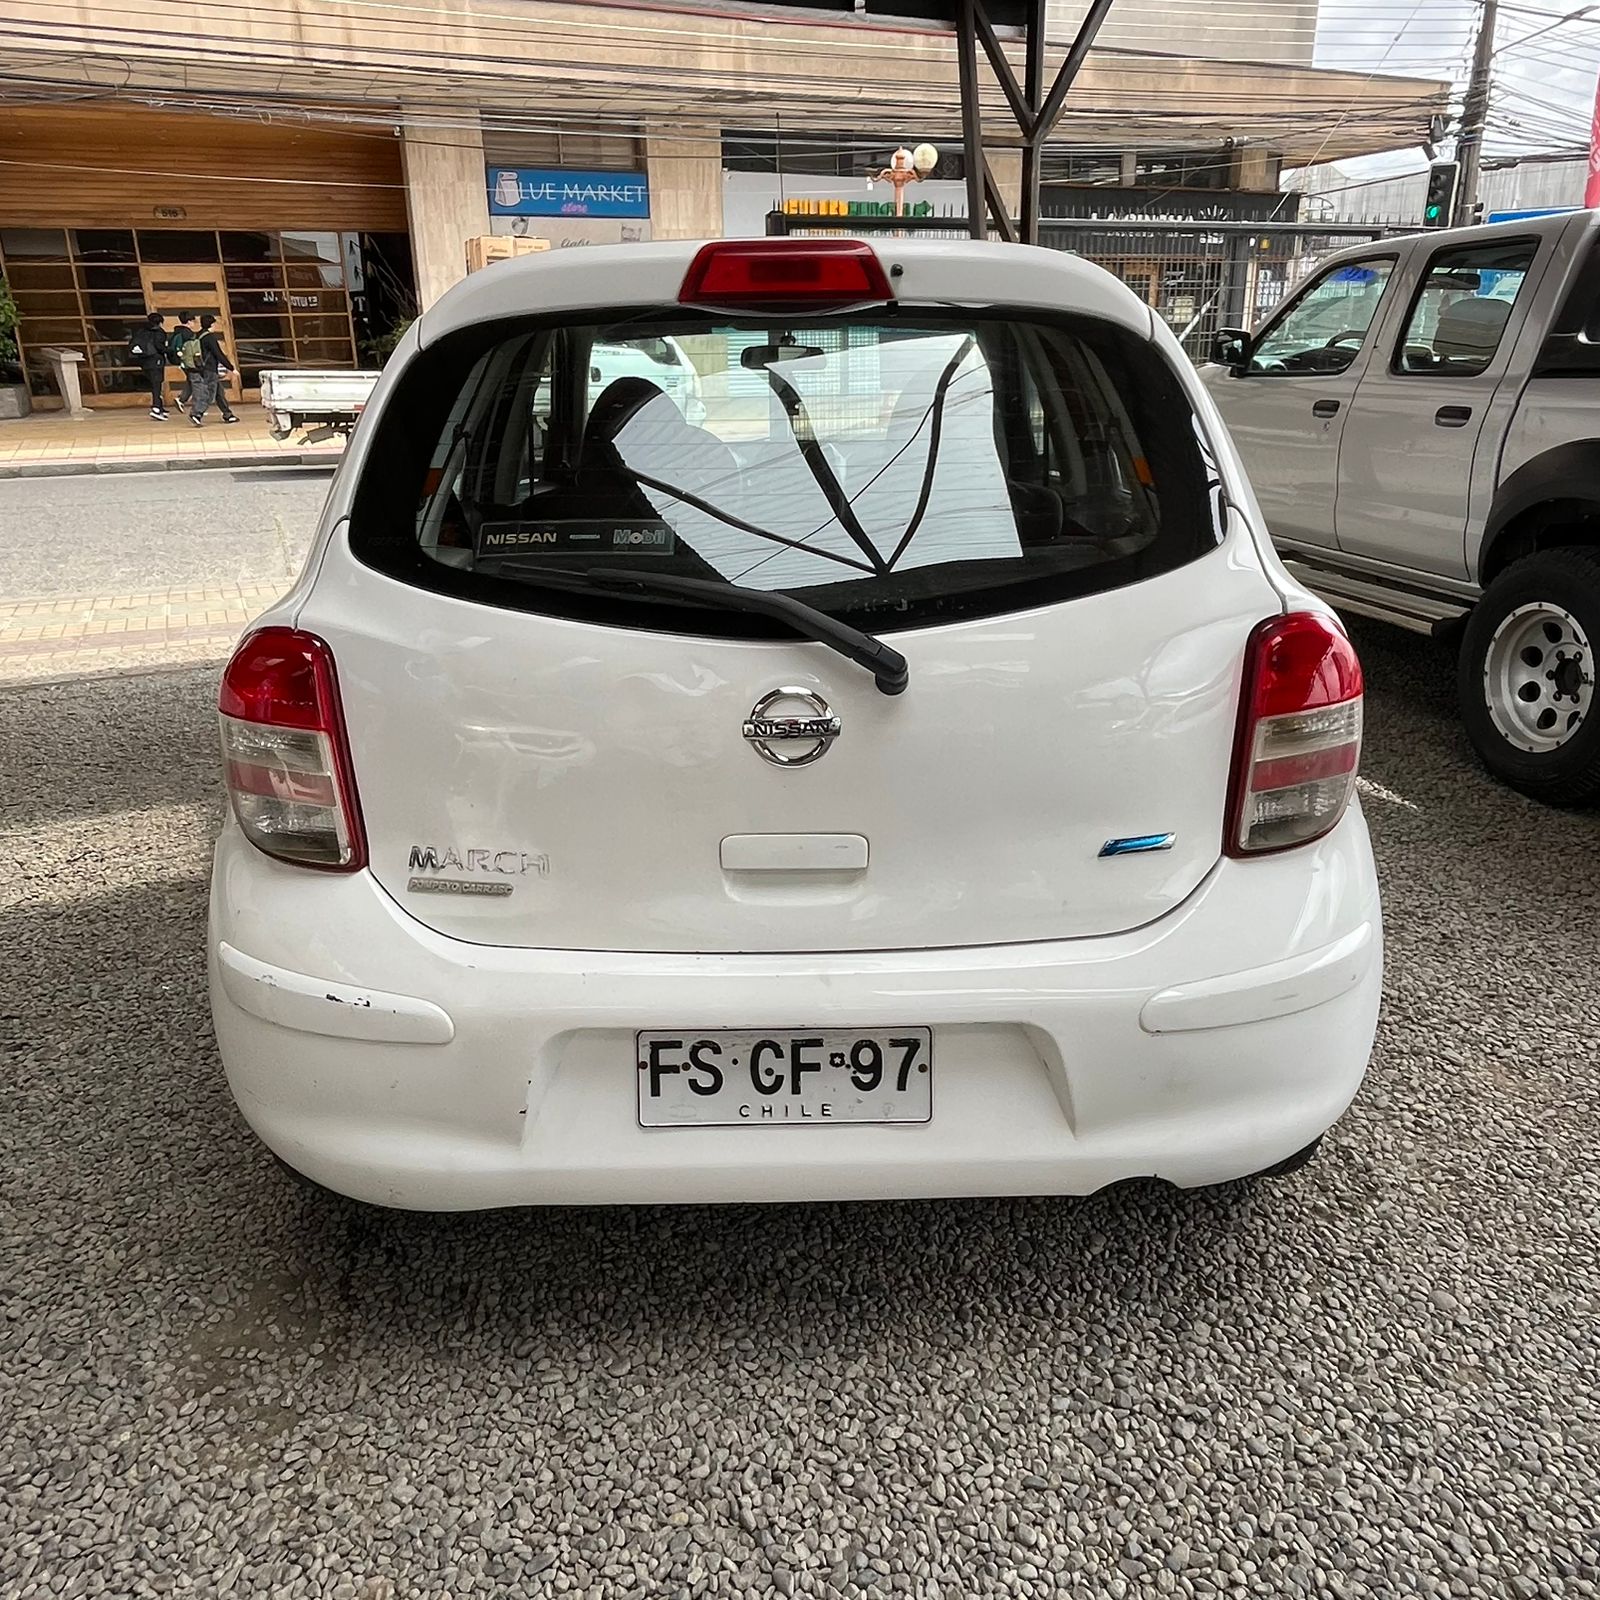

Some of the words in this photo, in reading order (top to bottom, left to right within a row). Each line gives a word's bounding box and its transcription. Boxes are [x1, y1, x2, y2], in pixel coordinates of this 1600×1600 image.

[562, 183, 646, 203] MARKET
[486, 532, 557, 545] NISSAN
[612, 529, 666, 545] Mobil
[753, 721, 831, 736] NISSAN
[408, 845, 551, 876] MARCH
[409, 879, 459, 891] POMPEYO
[849, 1038, 922, 1092] 97
[738, 1103, 832, 1118] CHILE
